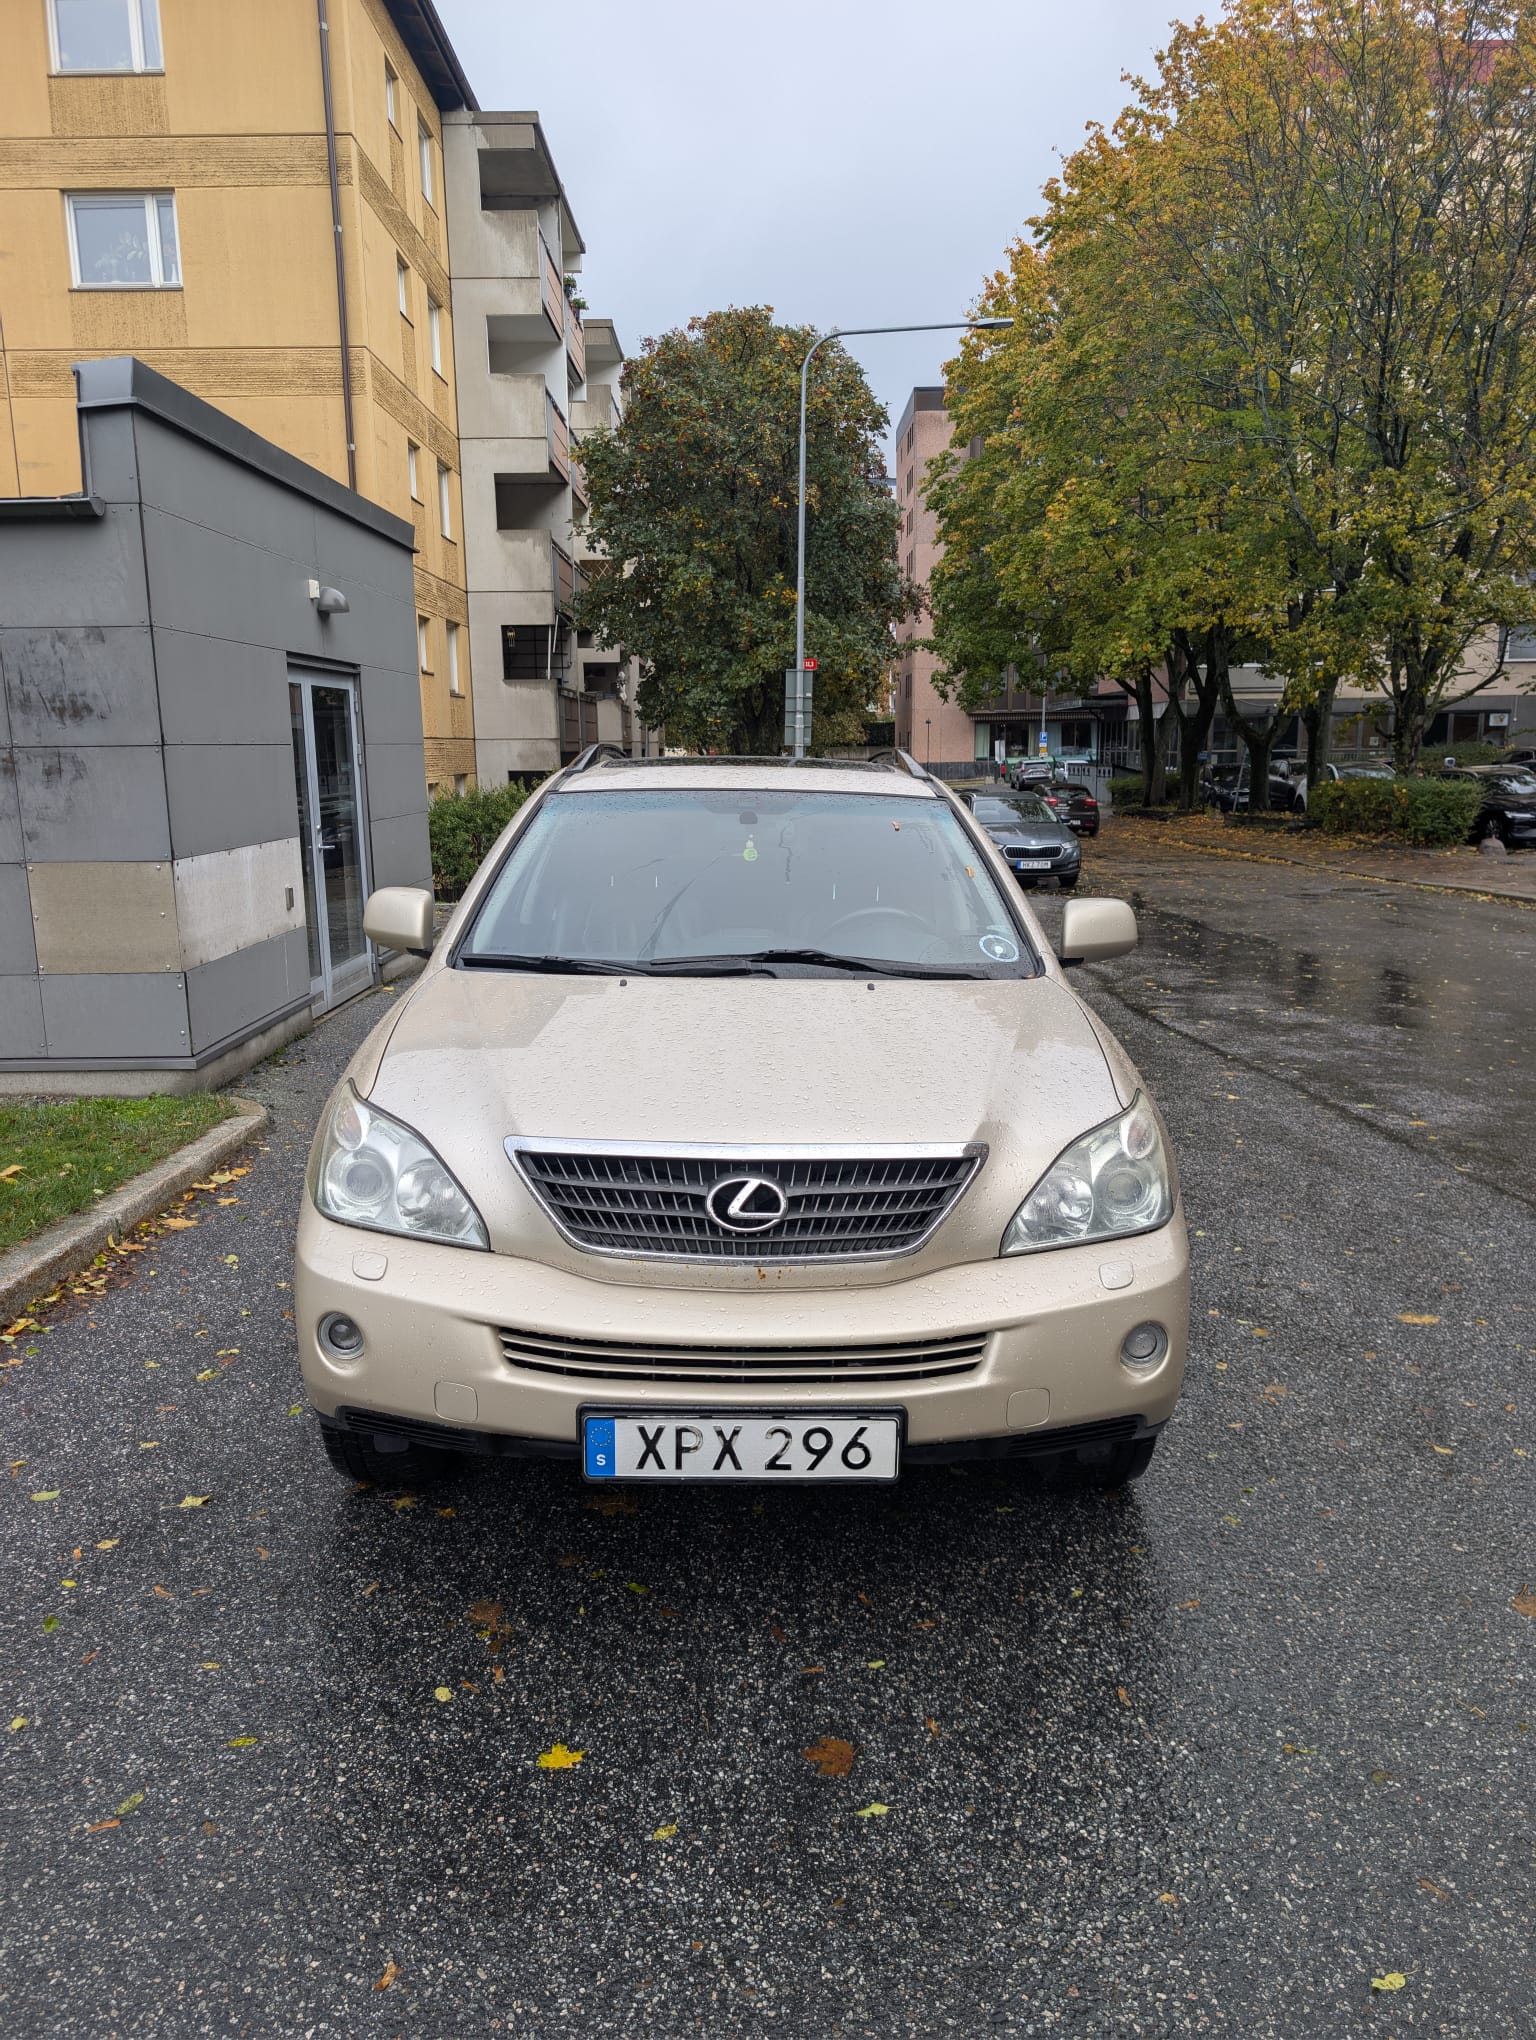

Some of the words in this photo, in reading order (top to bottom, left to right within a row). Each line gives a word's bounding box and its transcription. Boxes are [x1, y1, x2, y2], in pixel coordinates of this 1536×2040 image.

[596, 1454, 606, 1466] S
[635, 1425, 743, 1471] XPX
[764, 1425, 872, 1472] 296
